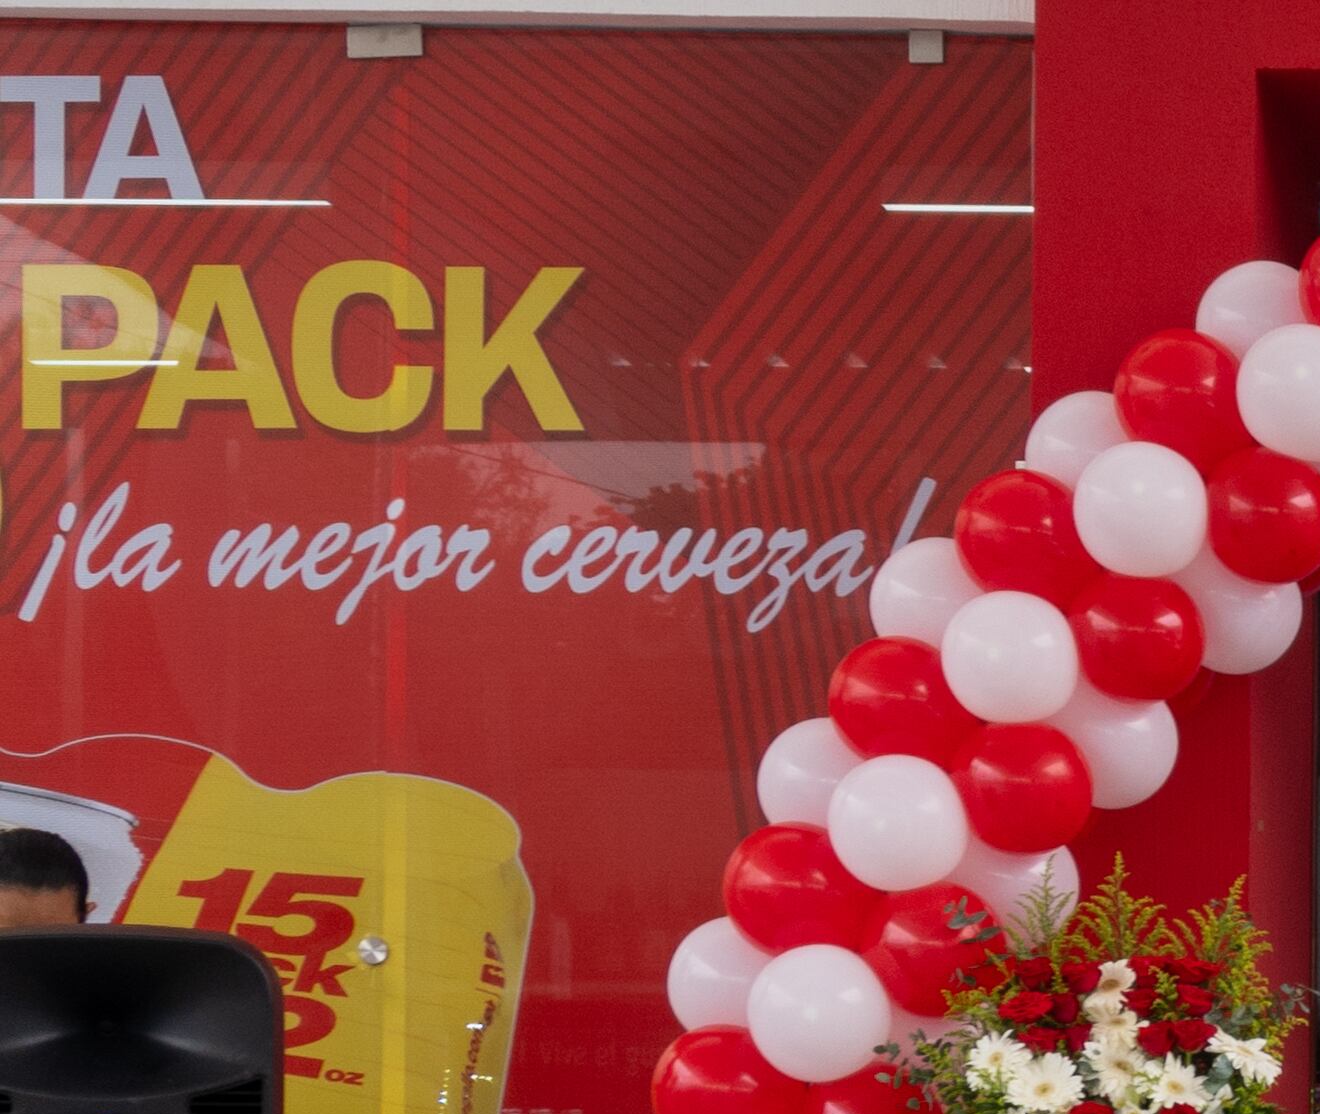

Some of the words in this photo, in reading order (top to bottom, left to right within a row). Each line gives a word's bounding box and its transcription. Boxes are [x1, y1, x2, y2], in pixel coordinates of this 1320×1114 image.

[21, 261, 584, 432] PACK
[18, 482, 181, 624] ¡la
[208, 498, 497, 626] mejor
[521, 477, 937, 634] cerveza!
[177, 868, 364, 956] 15
